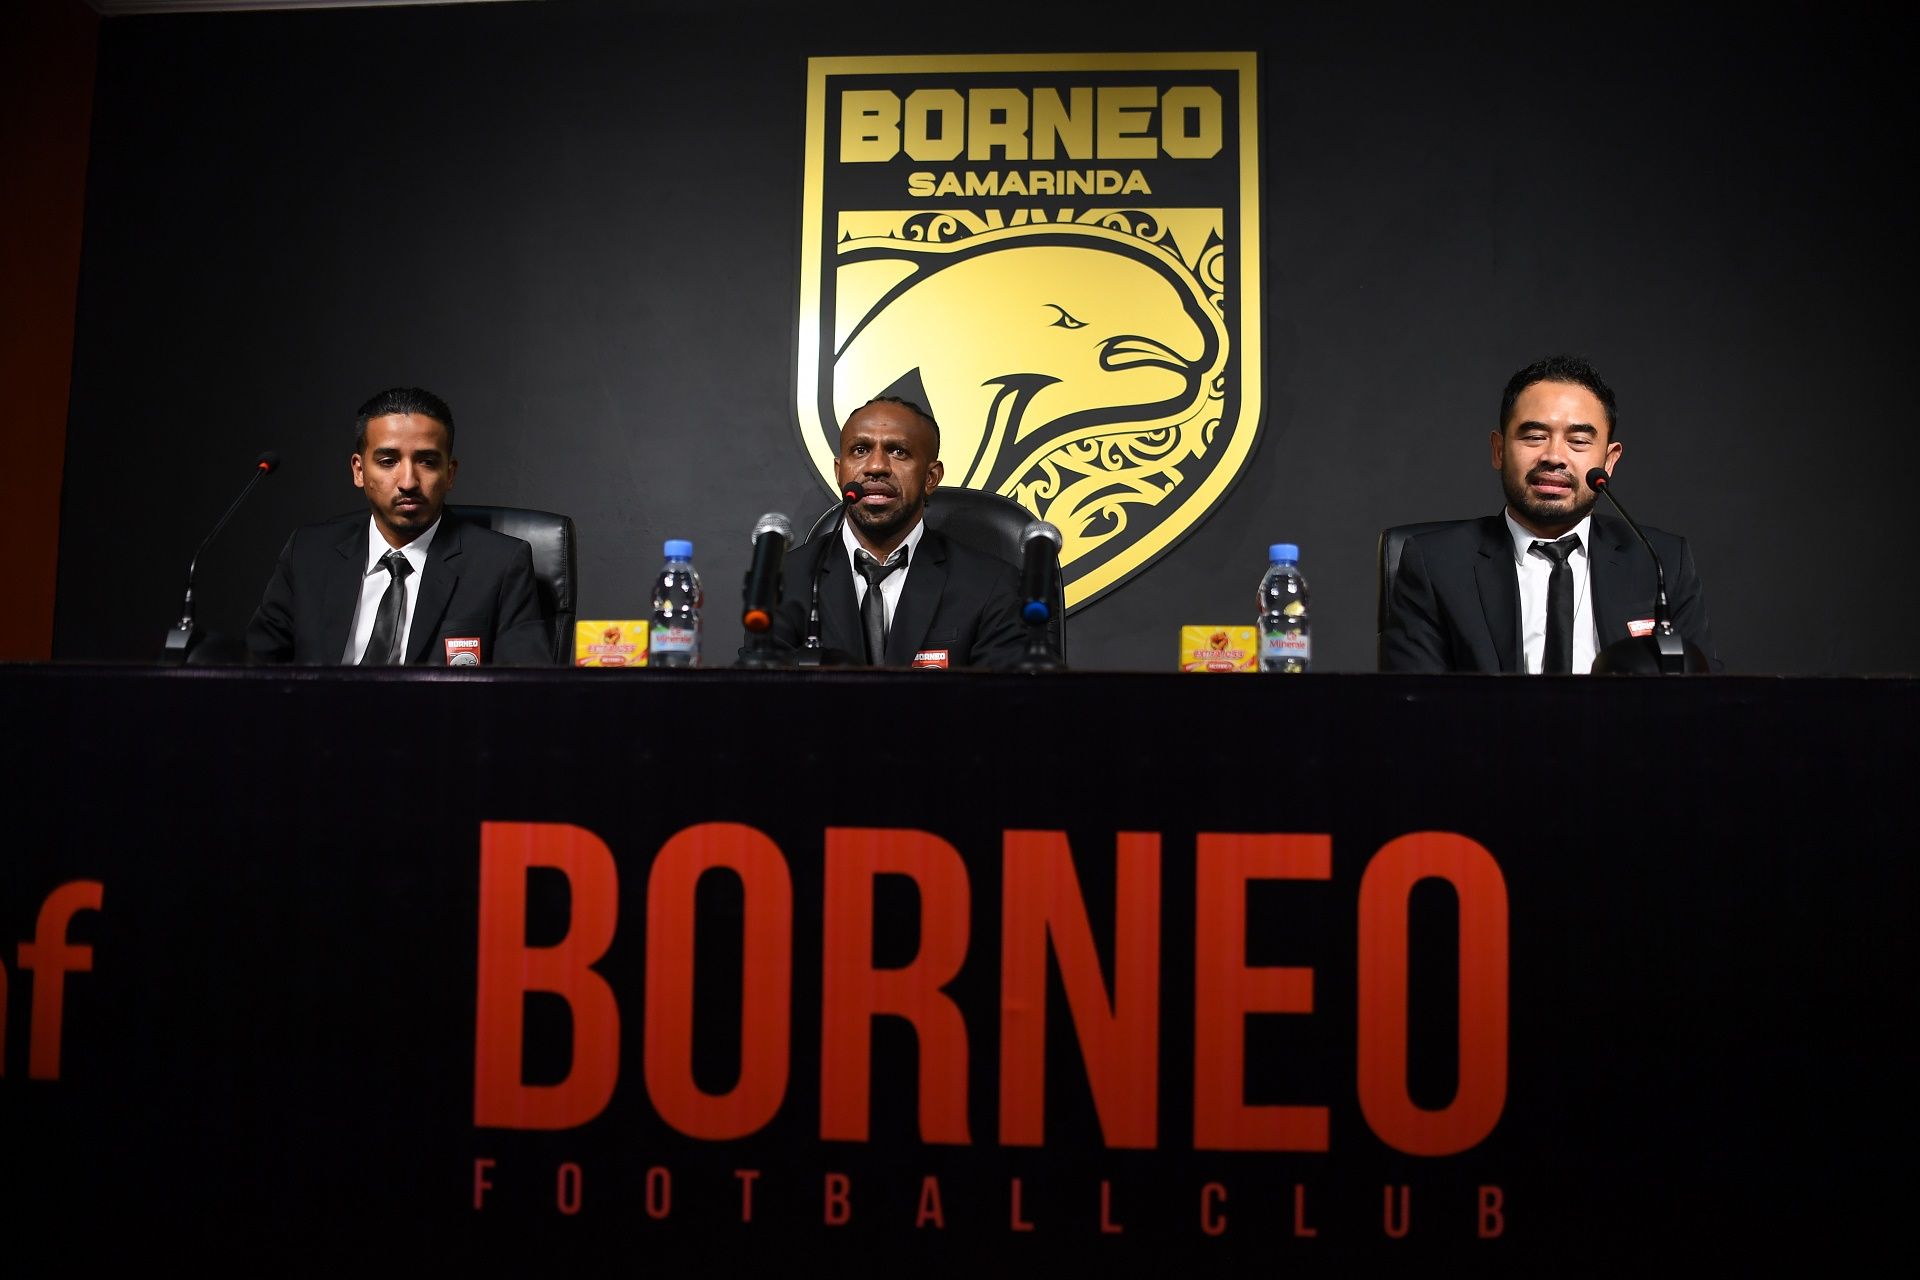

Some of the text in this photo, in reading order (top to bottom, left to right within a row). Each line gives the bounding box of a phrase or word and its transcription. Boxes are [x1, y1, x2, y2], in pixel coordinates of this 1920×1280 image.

[839, 86, 1223, 163] BORNEO
[908, 169, 1152, 197] SAMARINDA
[447, 640, 479, 648] BORNEO
[1269, 640, 1306, 649] Minerale
[0, 879, 104, 1080] f
[473, 819, 1510, 1157] BORNEO
[473, 1158, 1506, 1239] FOOTBALL CLUB
